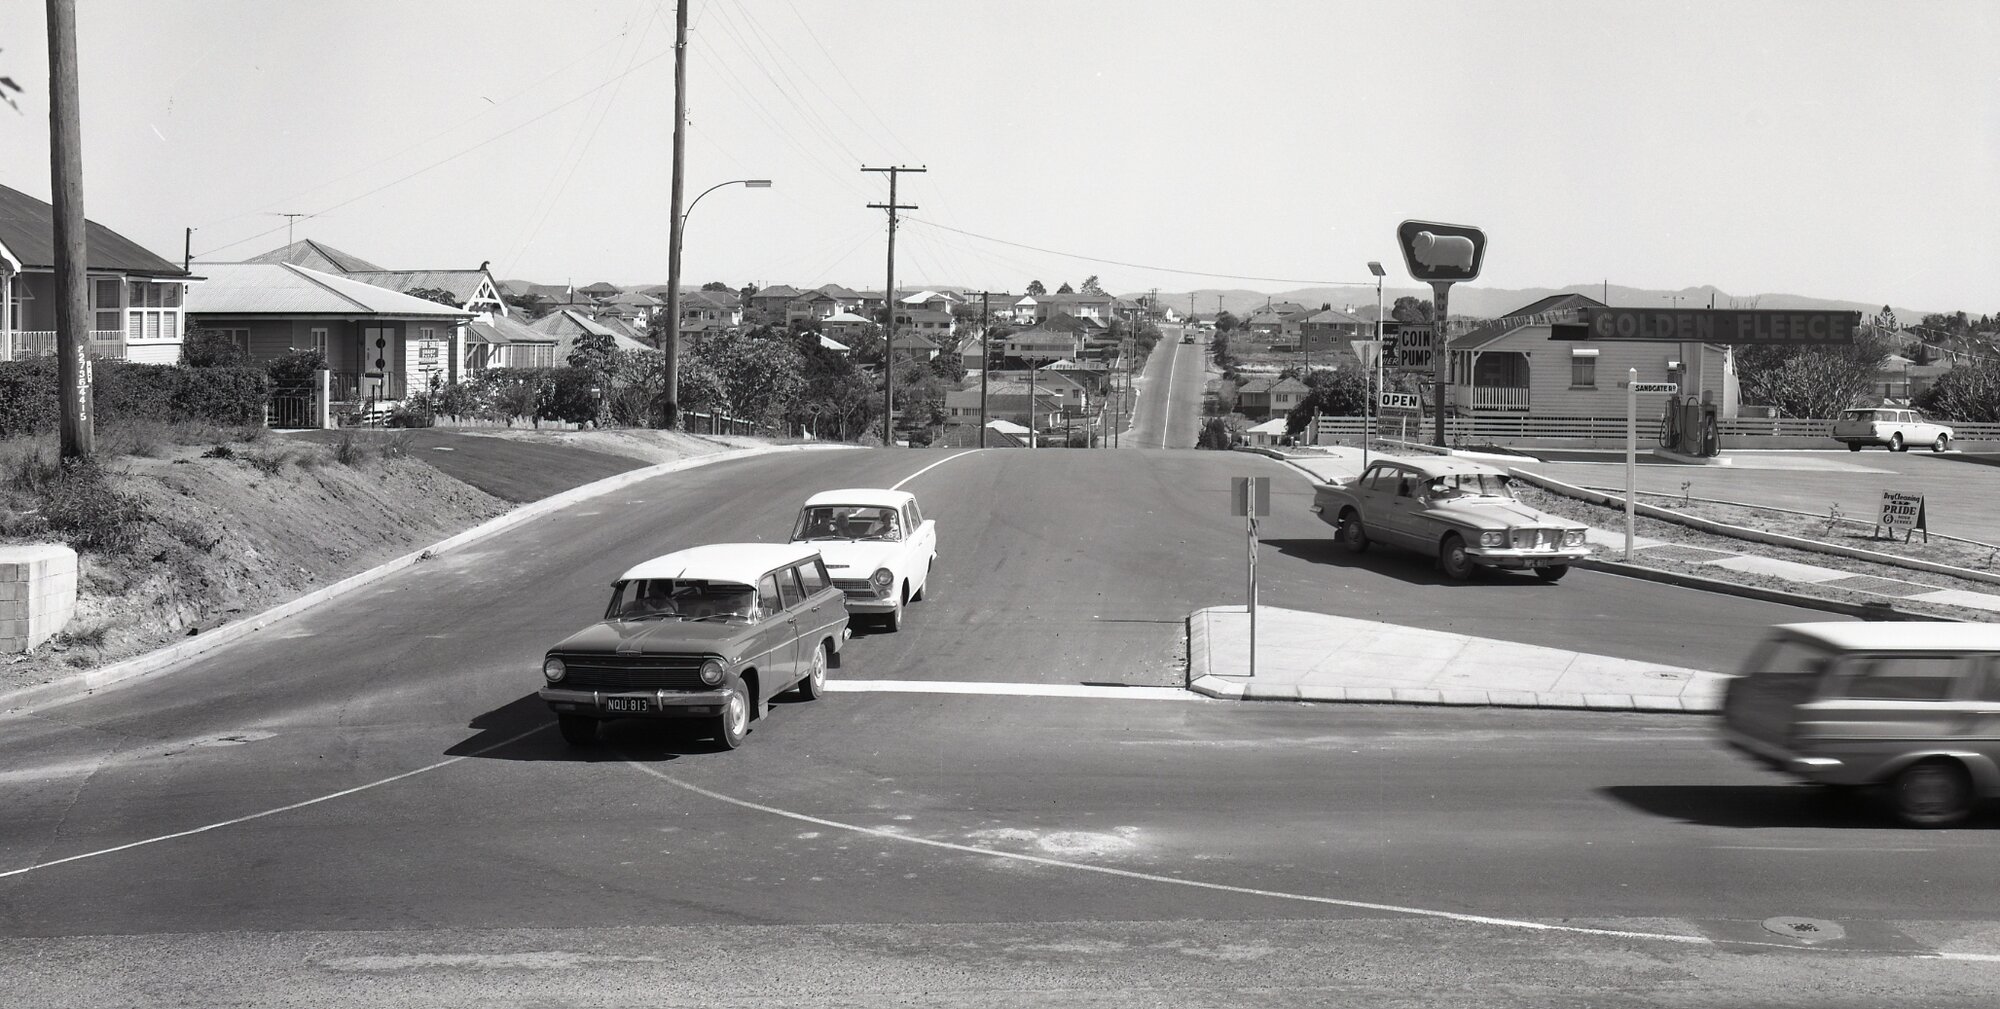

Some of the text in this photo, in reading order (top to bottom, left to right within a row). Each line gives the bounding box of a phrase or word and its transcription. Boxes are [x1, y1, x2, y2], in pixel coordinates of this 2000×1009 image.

[1596, 312, 1845, 340] GOLDEN FLEECE
[1402, 331, 1430, 347] COIN
[1401, 350, 1431, 366] PUMP
[1635, 384, 1668, 392] SANDGATE
[1382, 394, 1418, 407] OPEN
[1397, 429, 1418, 438] SEVICE
[1883, 505, 1917, 515] PRIDE
